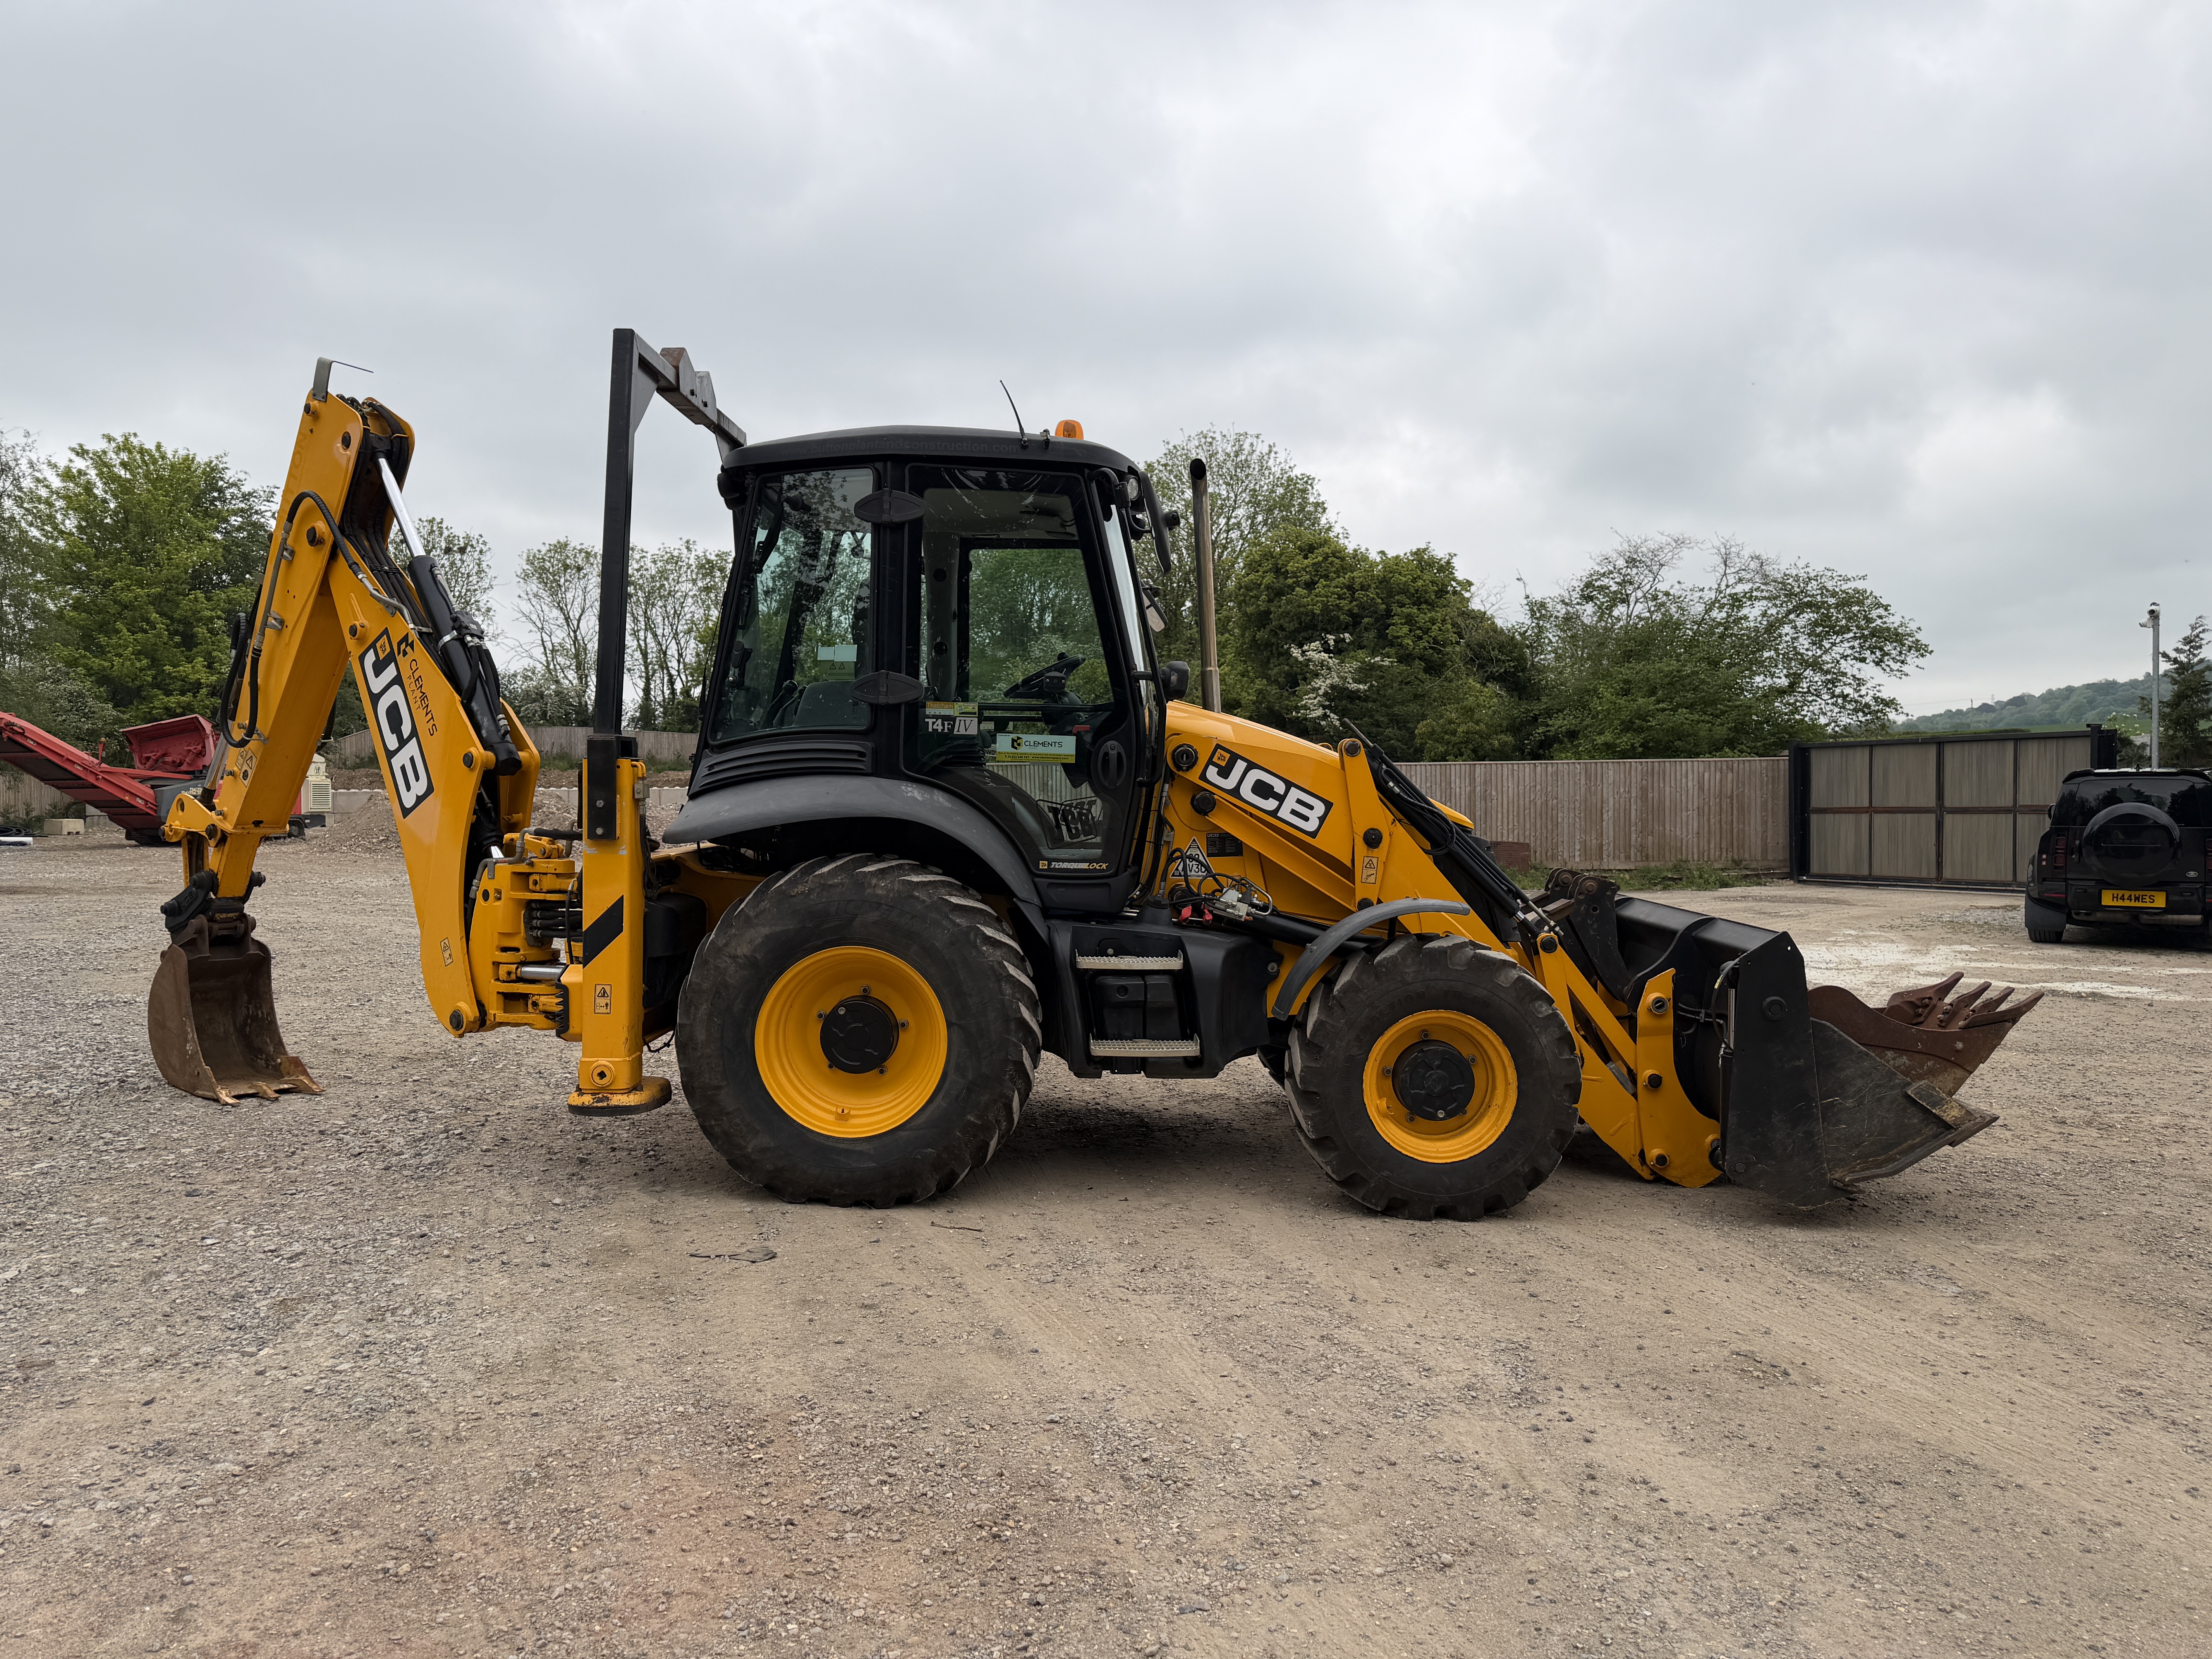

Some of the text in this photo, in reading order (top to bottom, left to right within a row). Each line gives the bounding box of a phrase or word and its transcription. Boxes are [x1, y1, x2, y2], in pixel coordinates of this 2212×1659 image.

[407, 675, 421, 710] PLANT
[410, 659, 437, 736] CLEMENTS
[364, 648, 427, 808] JCB
[925, 718, 974, 733] T4F IV
[1206, 759, 1325, 831] JCB
[2112, 893, 2155, 903] H44WES
